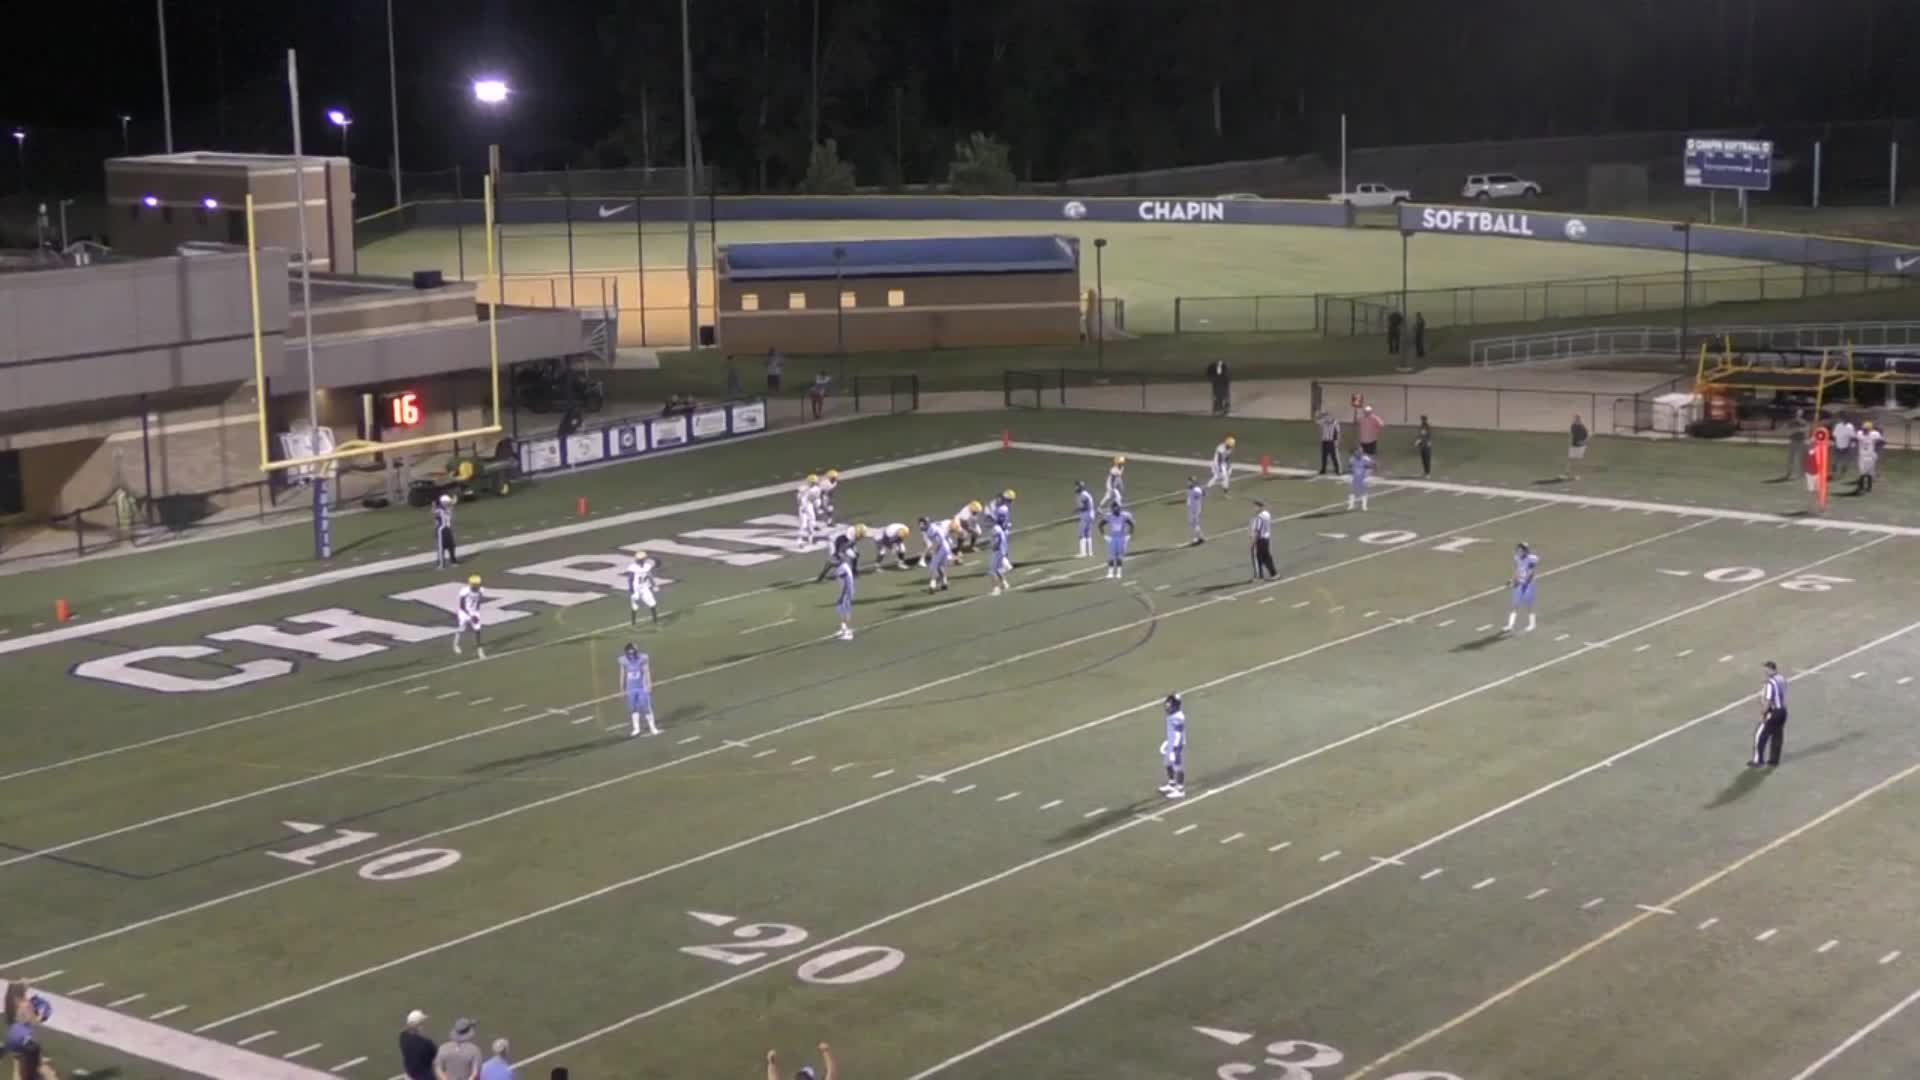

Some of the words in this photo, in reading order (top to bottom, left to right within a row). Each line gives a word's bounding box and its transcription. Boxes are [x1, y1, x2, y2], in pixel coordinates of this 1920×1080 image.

[1139, 202, 1224, 220] CHAPIN
[1423, 209, 1533, 235] SOFTBALL
[393, 394, 418, 424] 16
[70, 512, 842, 692] CHAPIN
[265, 828, 462, 880] 10
[680, 922, 905, 984] 20
